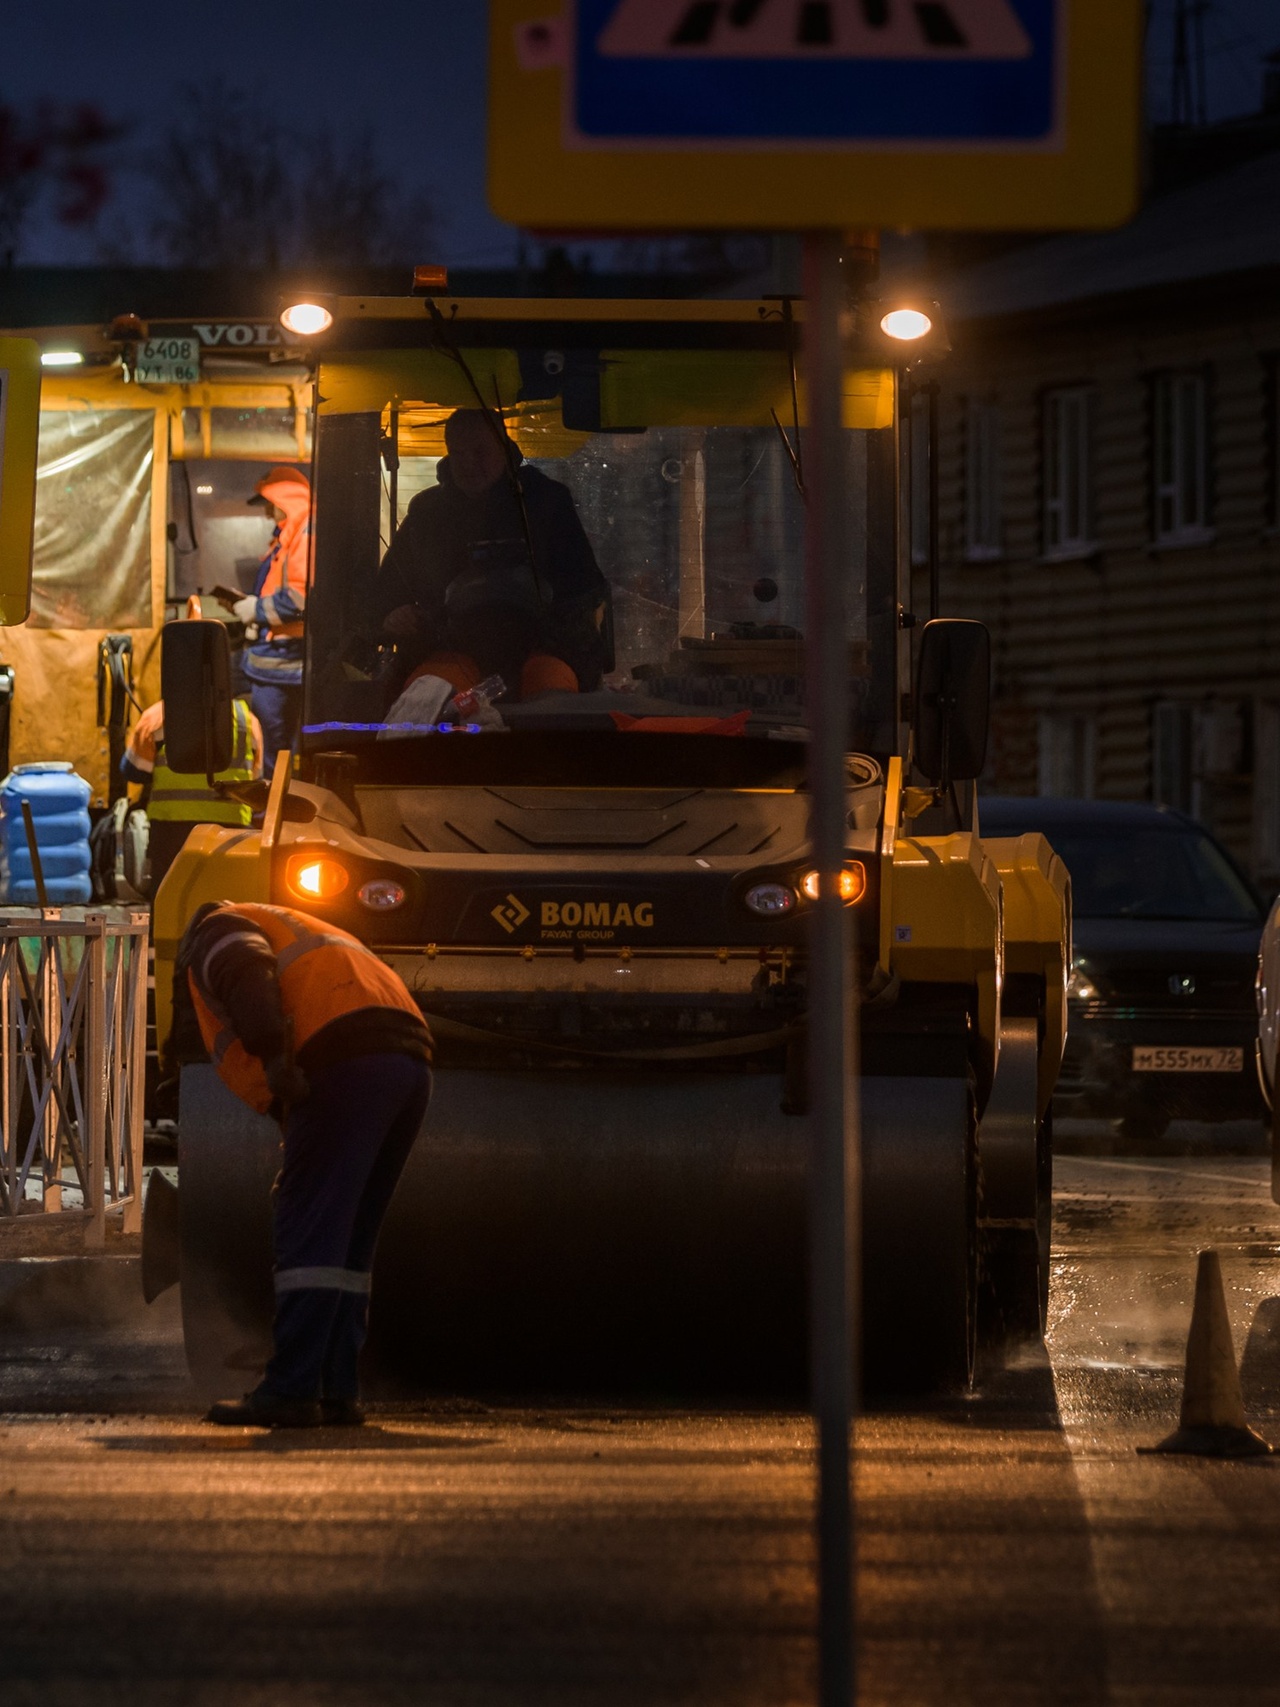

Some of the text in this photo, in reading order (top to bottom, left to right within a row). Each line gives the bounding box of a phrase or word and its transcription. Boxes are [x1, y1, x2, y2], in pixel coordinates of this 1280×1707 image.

[143, 340, 192, 360] 6408
[540, 901, 654, 927] BOMAG
[541, 930, 615, 939] FAYAT GROUP
